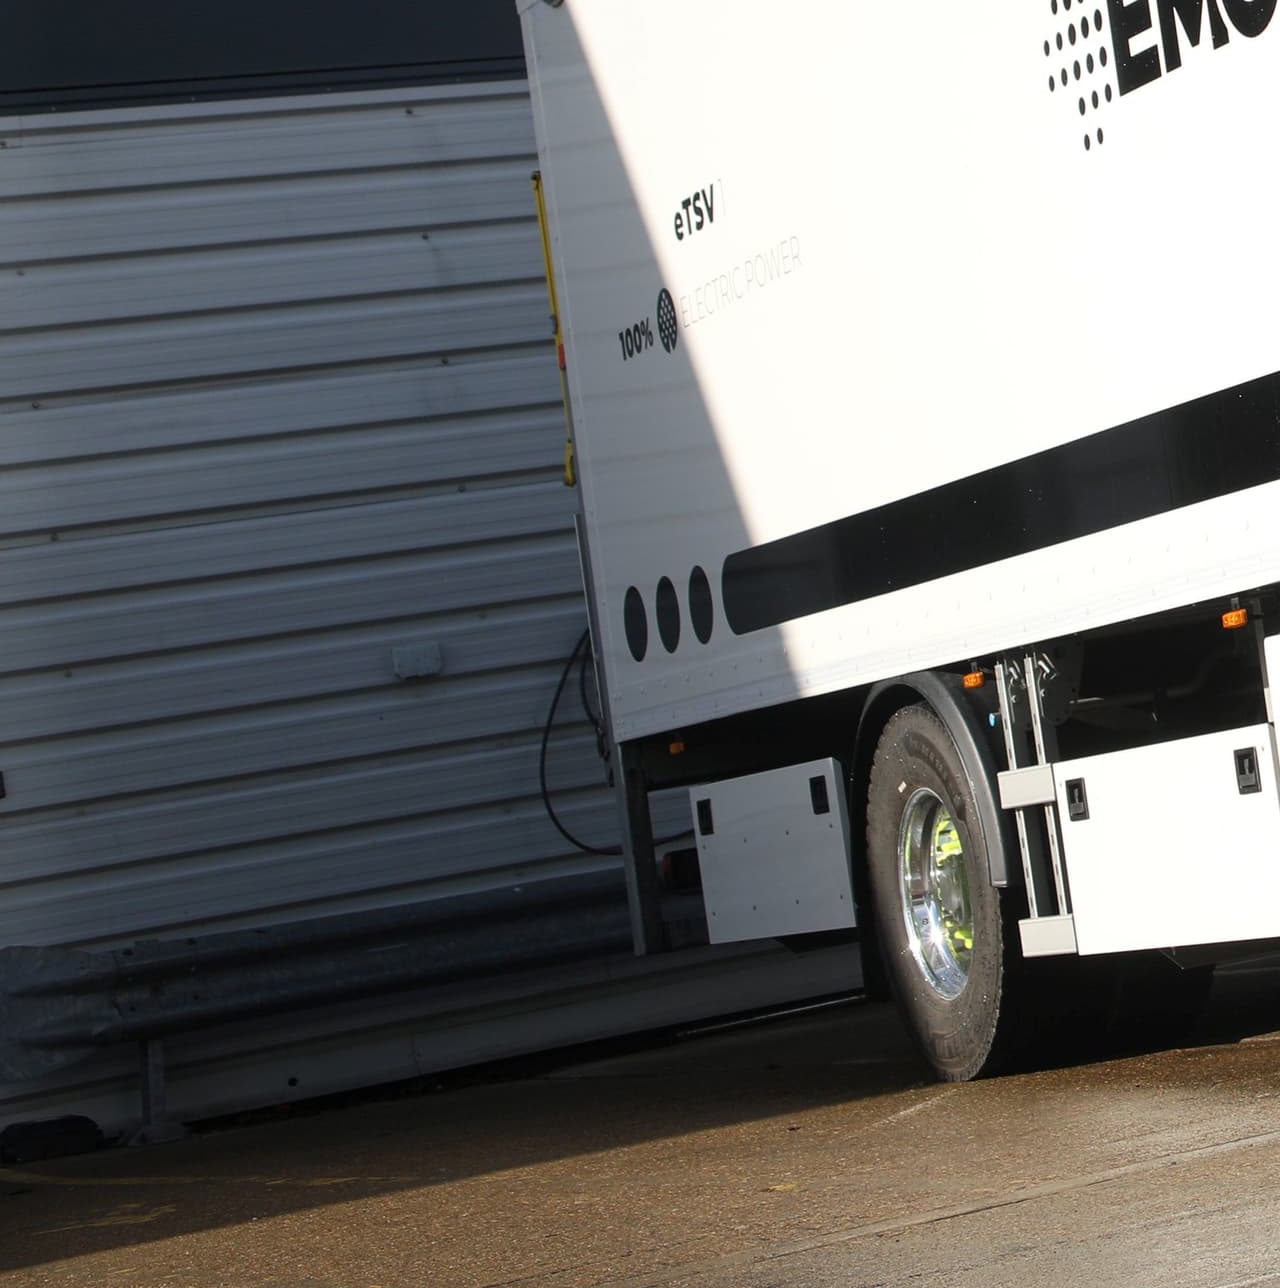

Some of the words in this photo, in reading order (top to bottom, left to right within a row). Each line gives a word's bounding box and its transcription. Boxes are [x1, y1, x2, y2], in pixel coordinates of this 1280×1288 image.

[674, 183, 714, 242] eTSV
[618, 317, 655, 361] 100%
[679, 266, 744, 329] ELECTRIC
[744, 235, 804, 289] POWER
